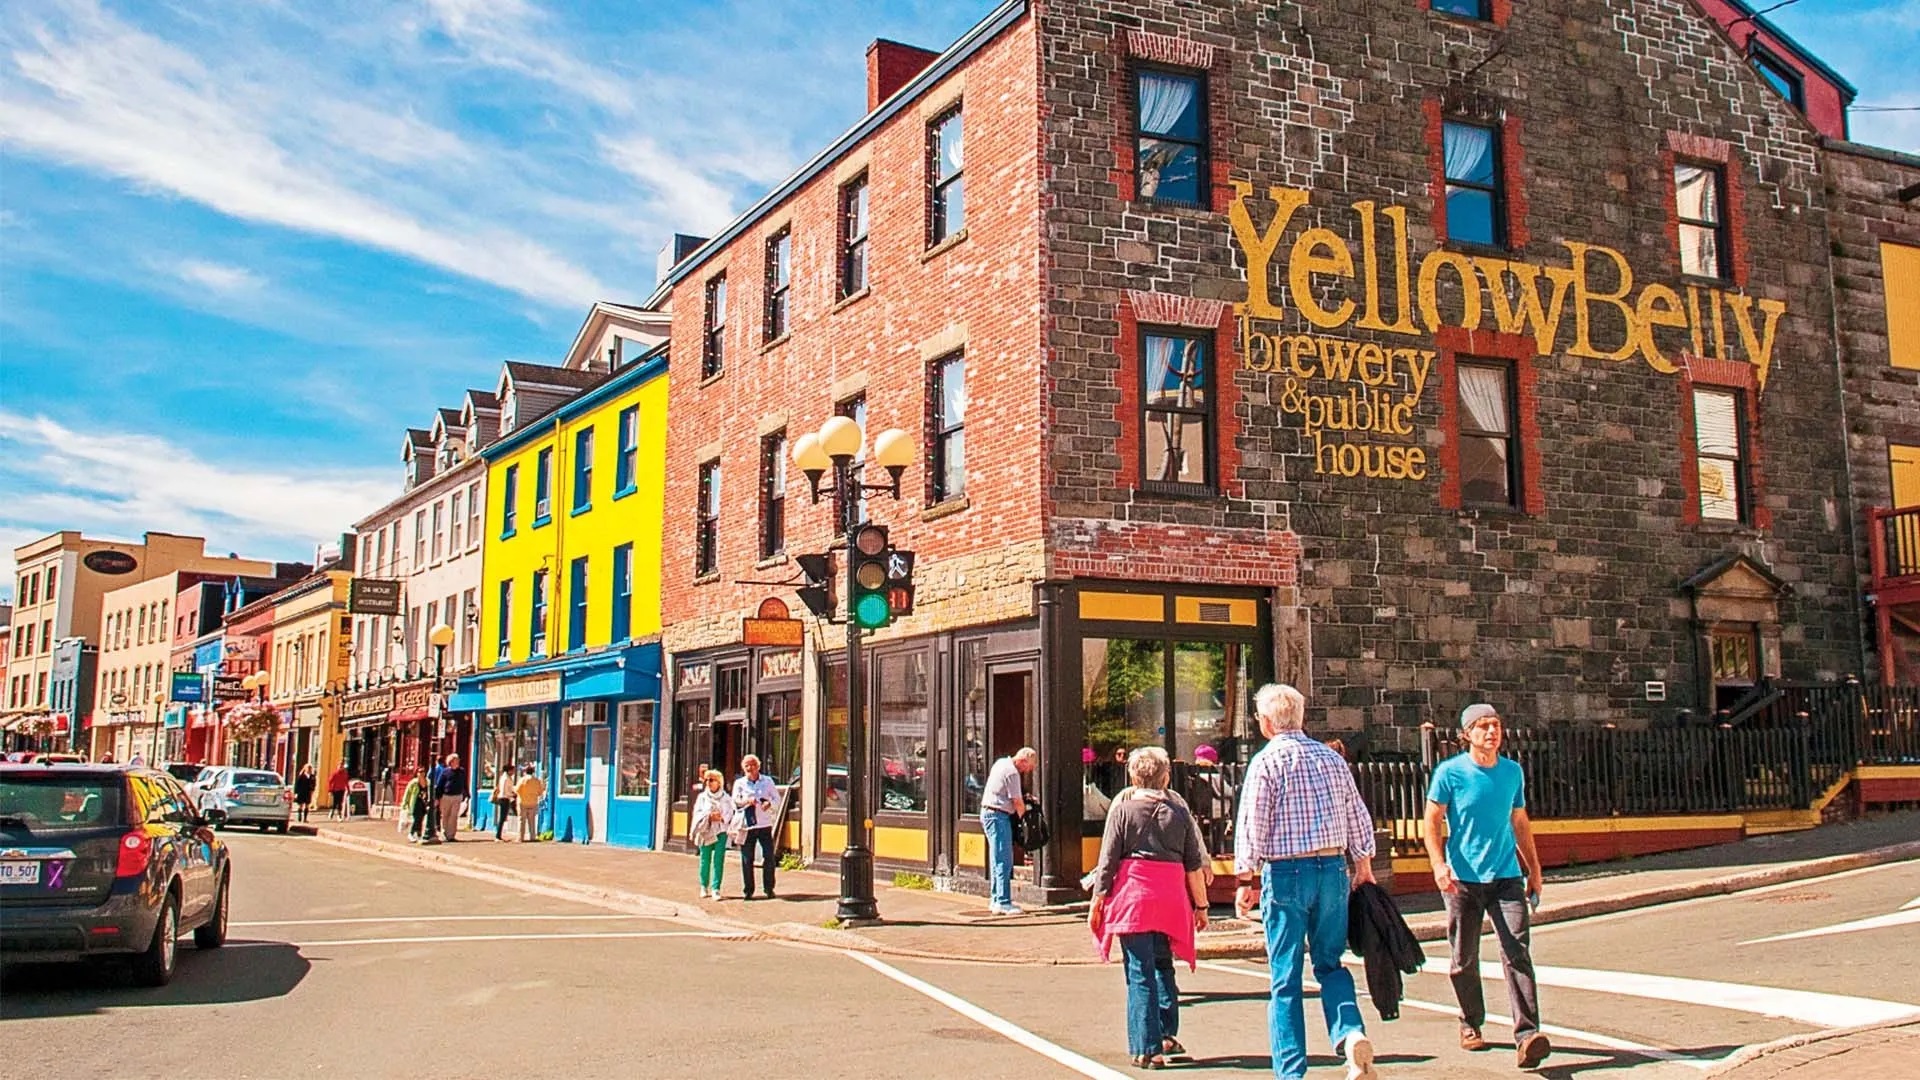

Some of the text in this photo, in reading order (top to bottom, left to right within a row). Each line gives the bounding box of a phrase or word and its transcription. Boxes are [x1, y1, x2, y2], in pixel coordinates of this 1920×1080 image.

[1228, 180, 1786, 394] YellowBelly
[1243, 313, 1436, 407] brewery
[1314, 430, 1426, 480] house
[18, 865, 38, 877] 507
